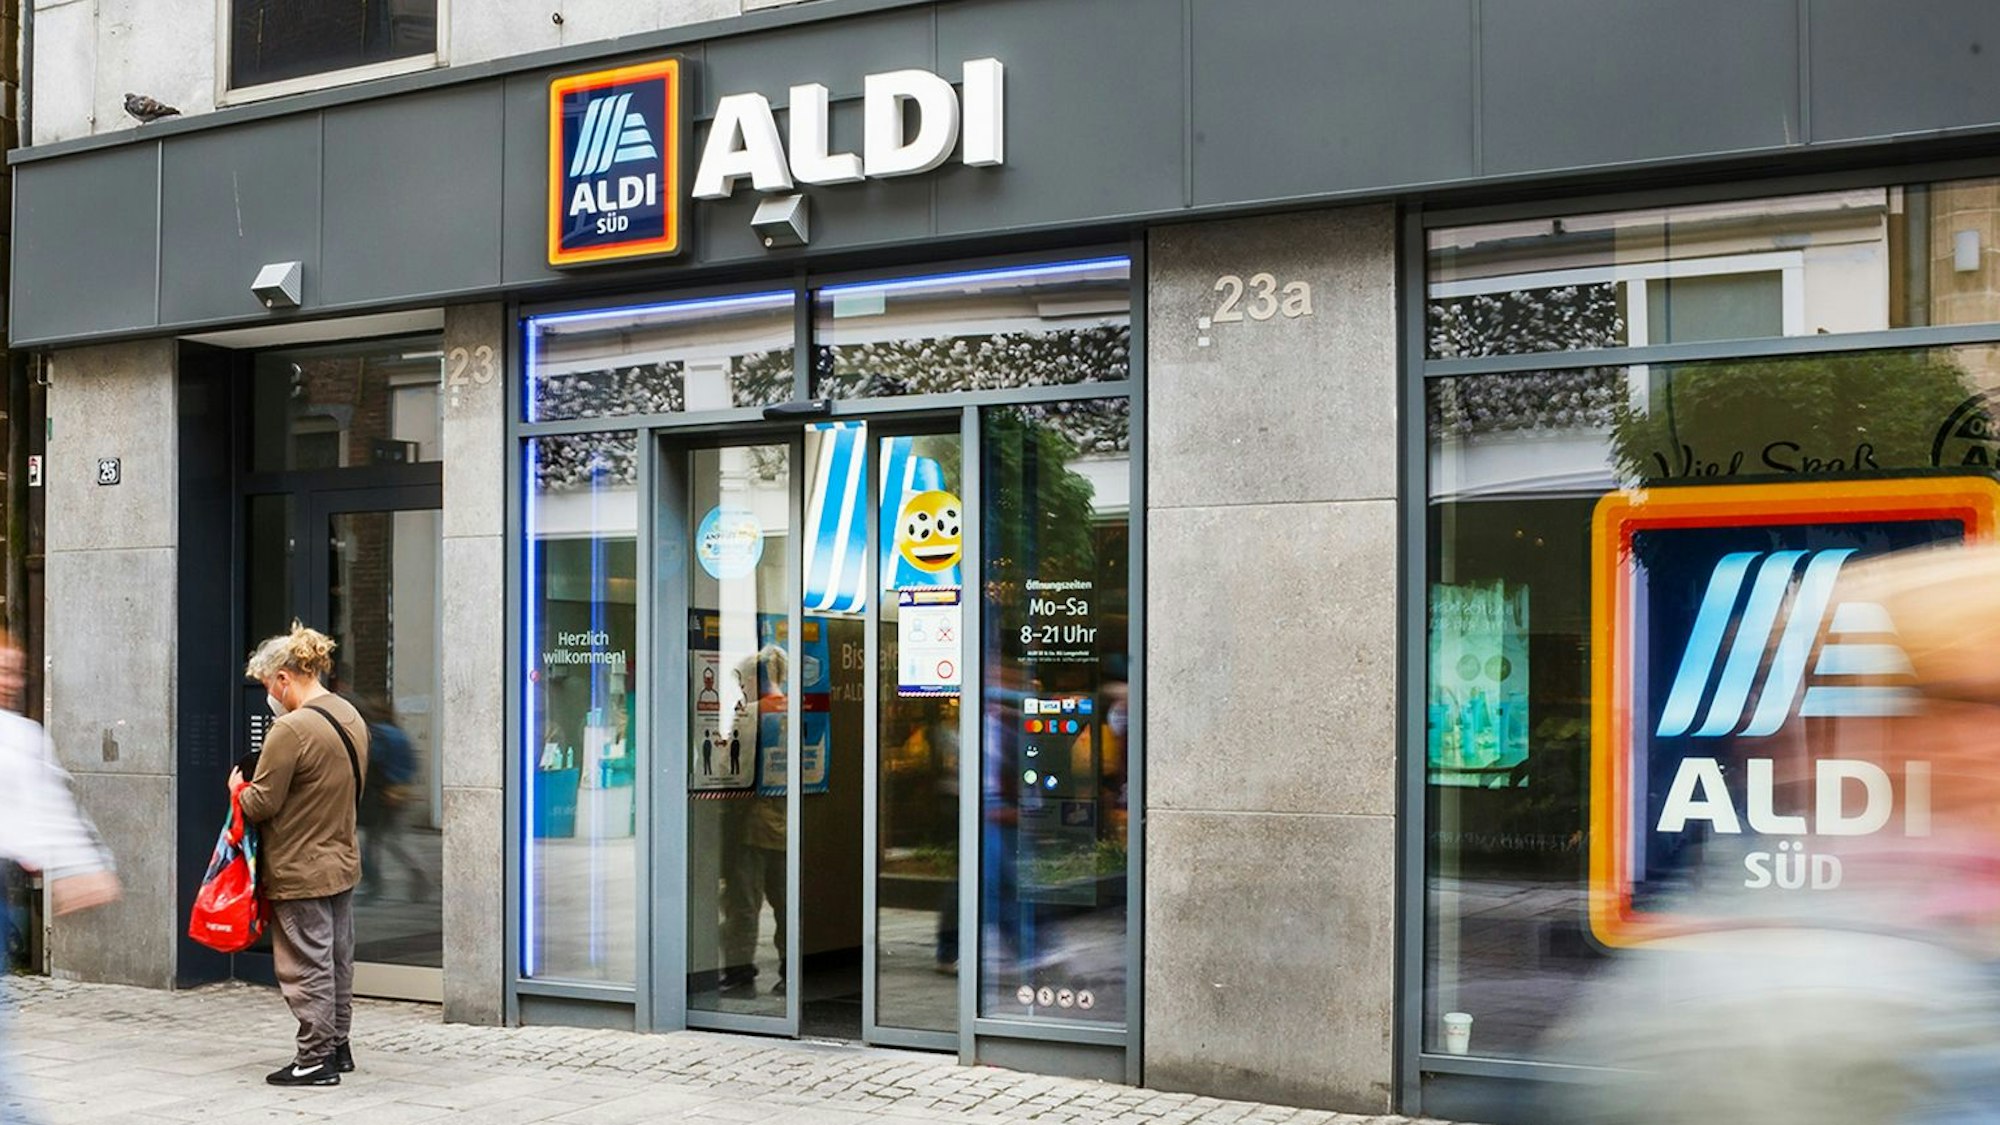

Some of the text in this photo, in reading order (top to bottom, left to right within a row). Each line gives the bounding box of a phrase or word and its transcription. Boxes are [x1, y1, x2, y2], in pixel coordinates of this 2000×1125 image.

[692, 57, 1004, 198] ALDI
[569, 173, 656, 217] ALDI
[596, 211, 629, 235] SÜD
[1212, 272, 1313, 323] 23a
[449, 345, 495, 386] 23
[1025, 579, 1092, 592] Öffnungszeiten
[557, 630, 609, 646] Herzlich
[1063, 624, 1097, 643] Uhr
[542, 649, 627, 664] willkommen!
[1656, 757, 1932, 837] ALDI
[1744, 841, 1842, 890] SÜD
